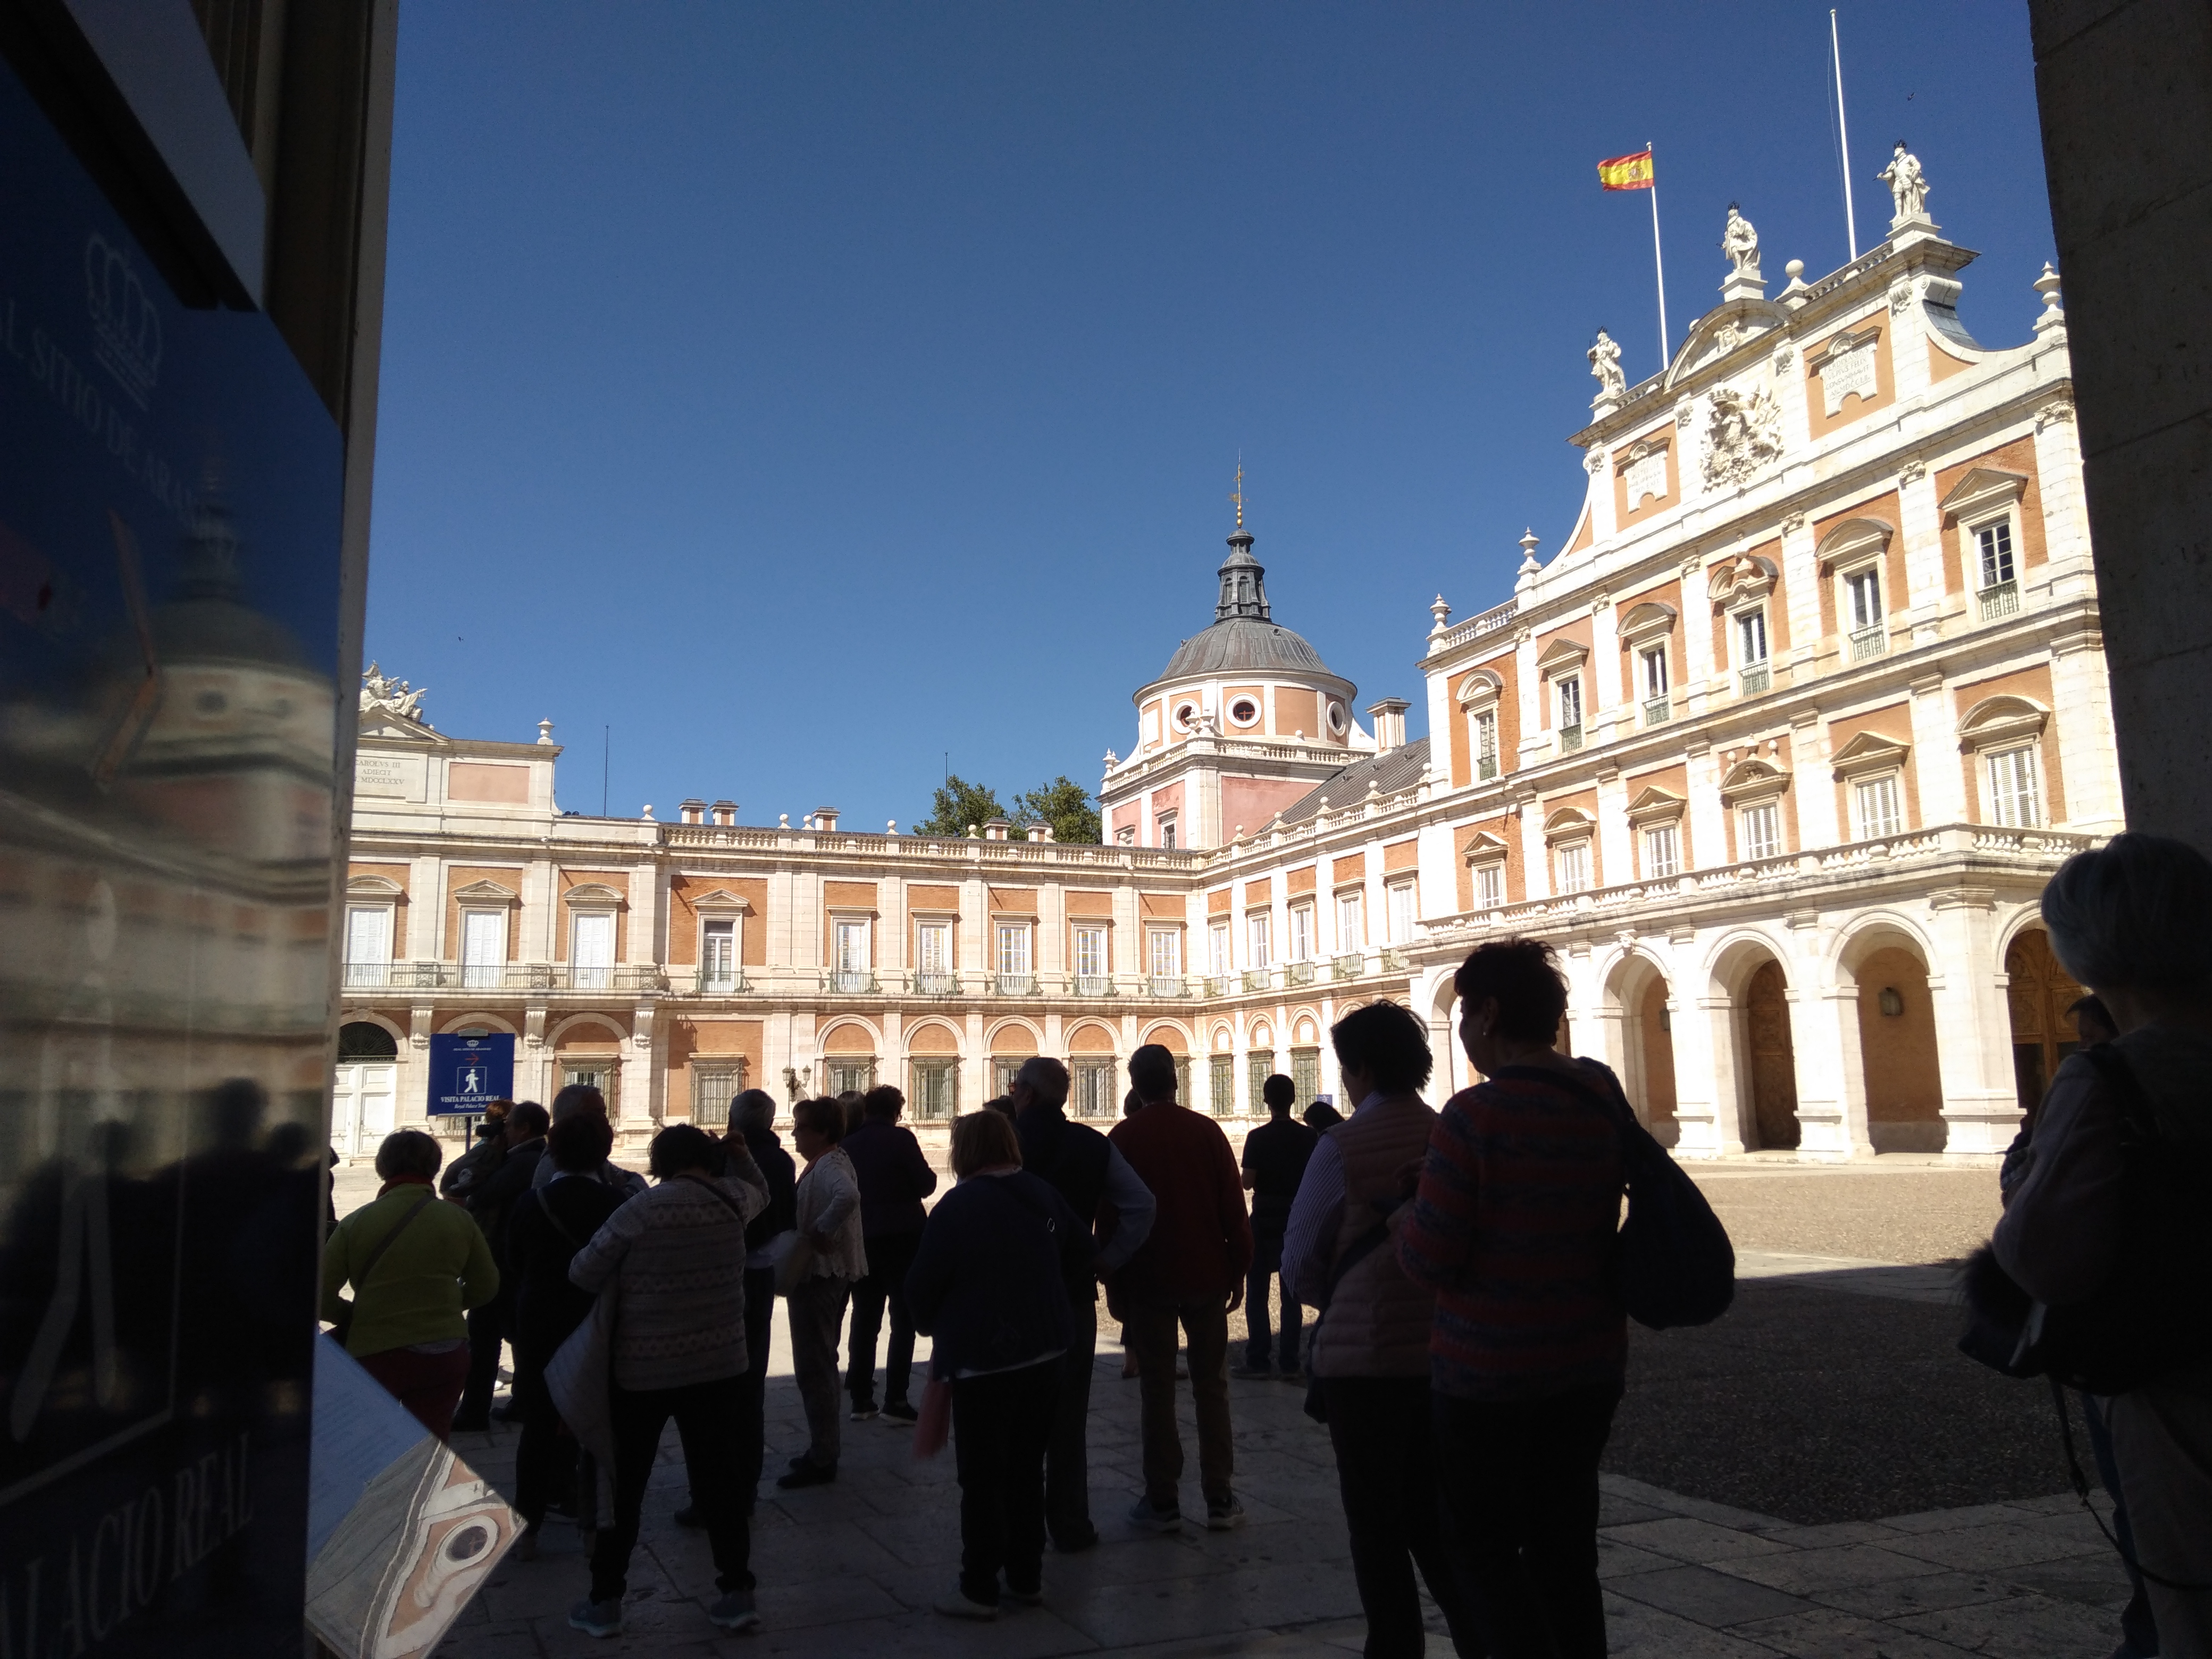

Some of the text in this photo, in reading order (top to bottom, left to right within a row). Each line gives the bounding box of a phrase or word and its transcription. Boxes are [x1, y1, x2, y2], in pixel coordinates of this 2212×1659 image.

[31, 326, 102, 434] SITIO
[107, 405, 138, 475] DE
[170, 1429, 254, 1583] REAL
